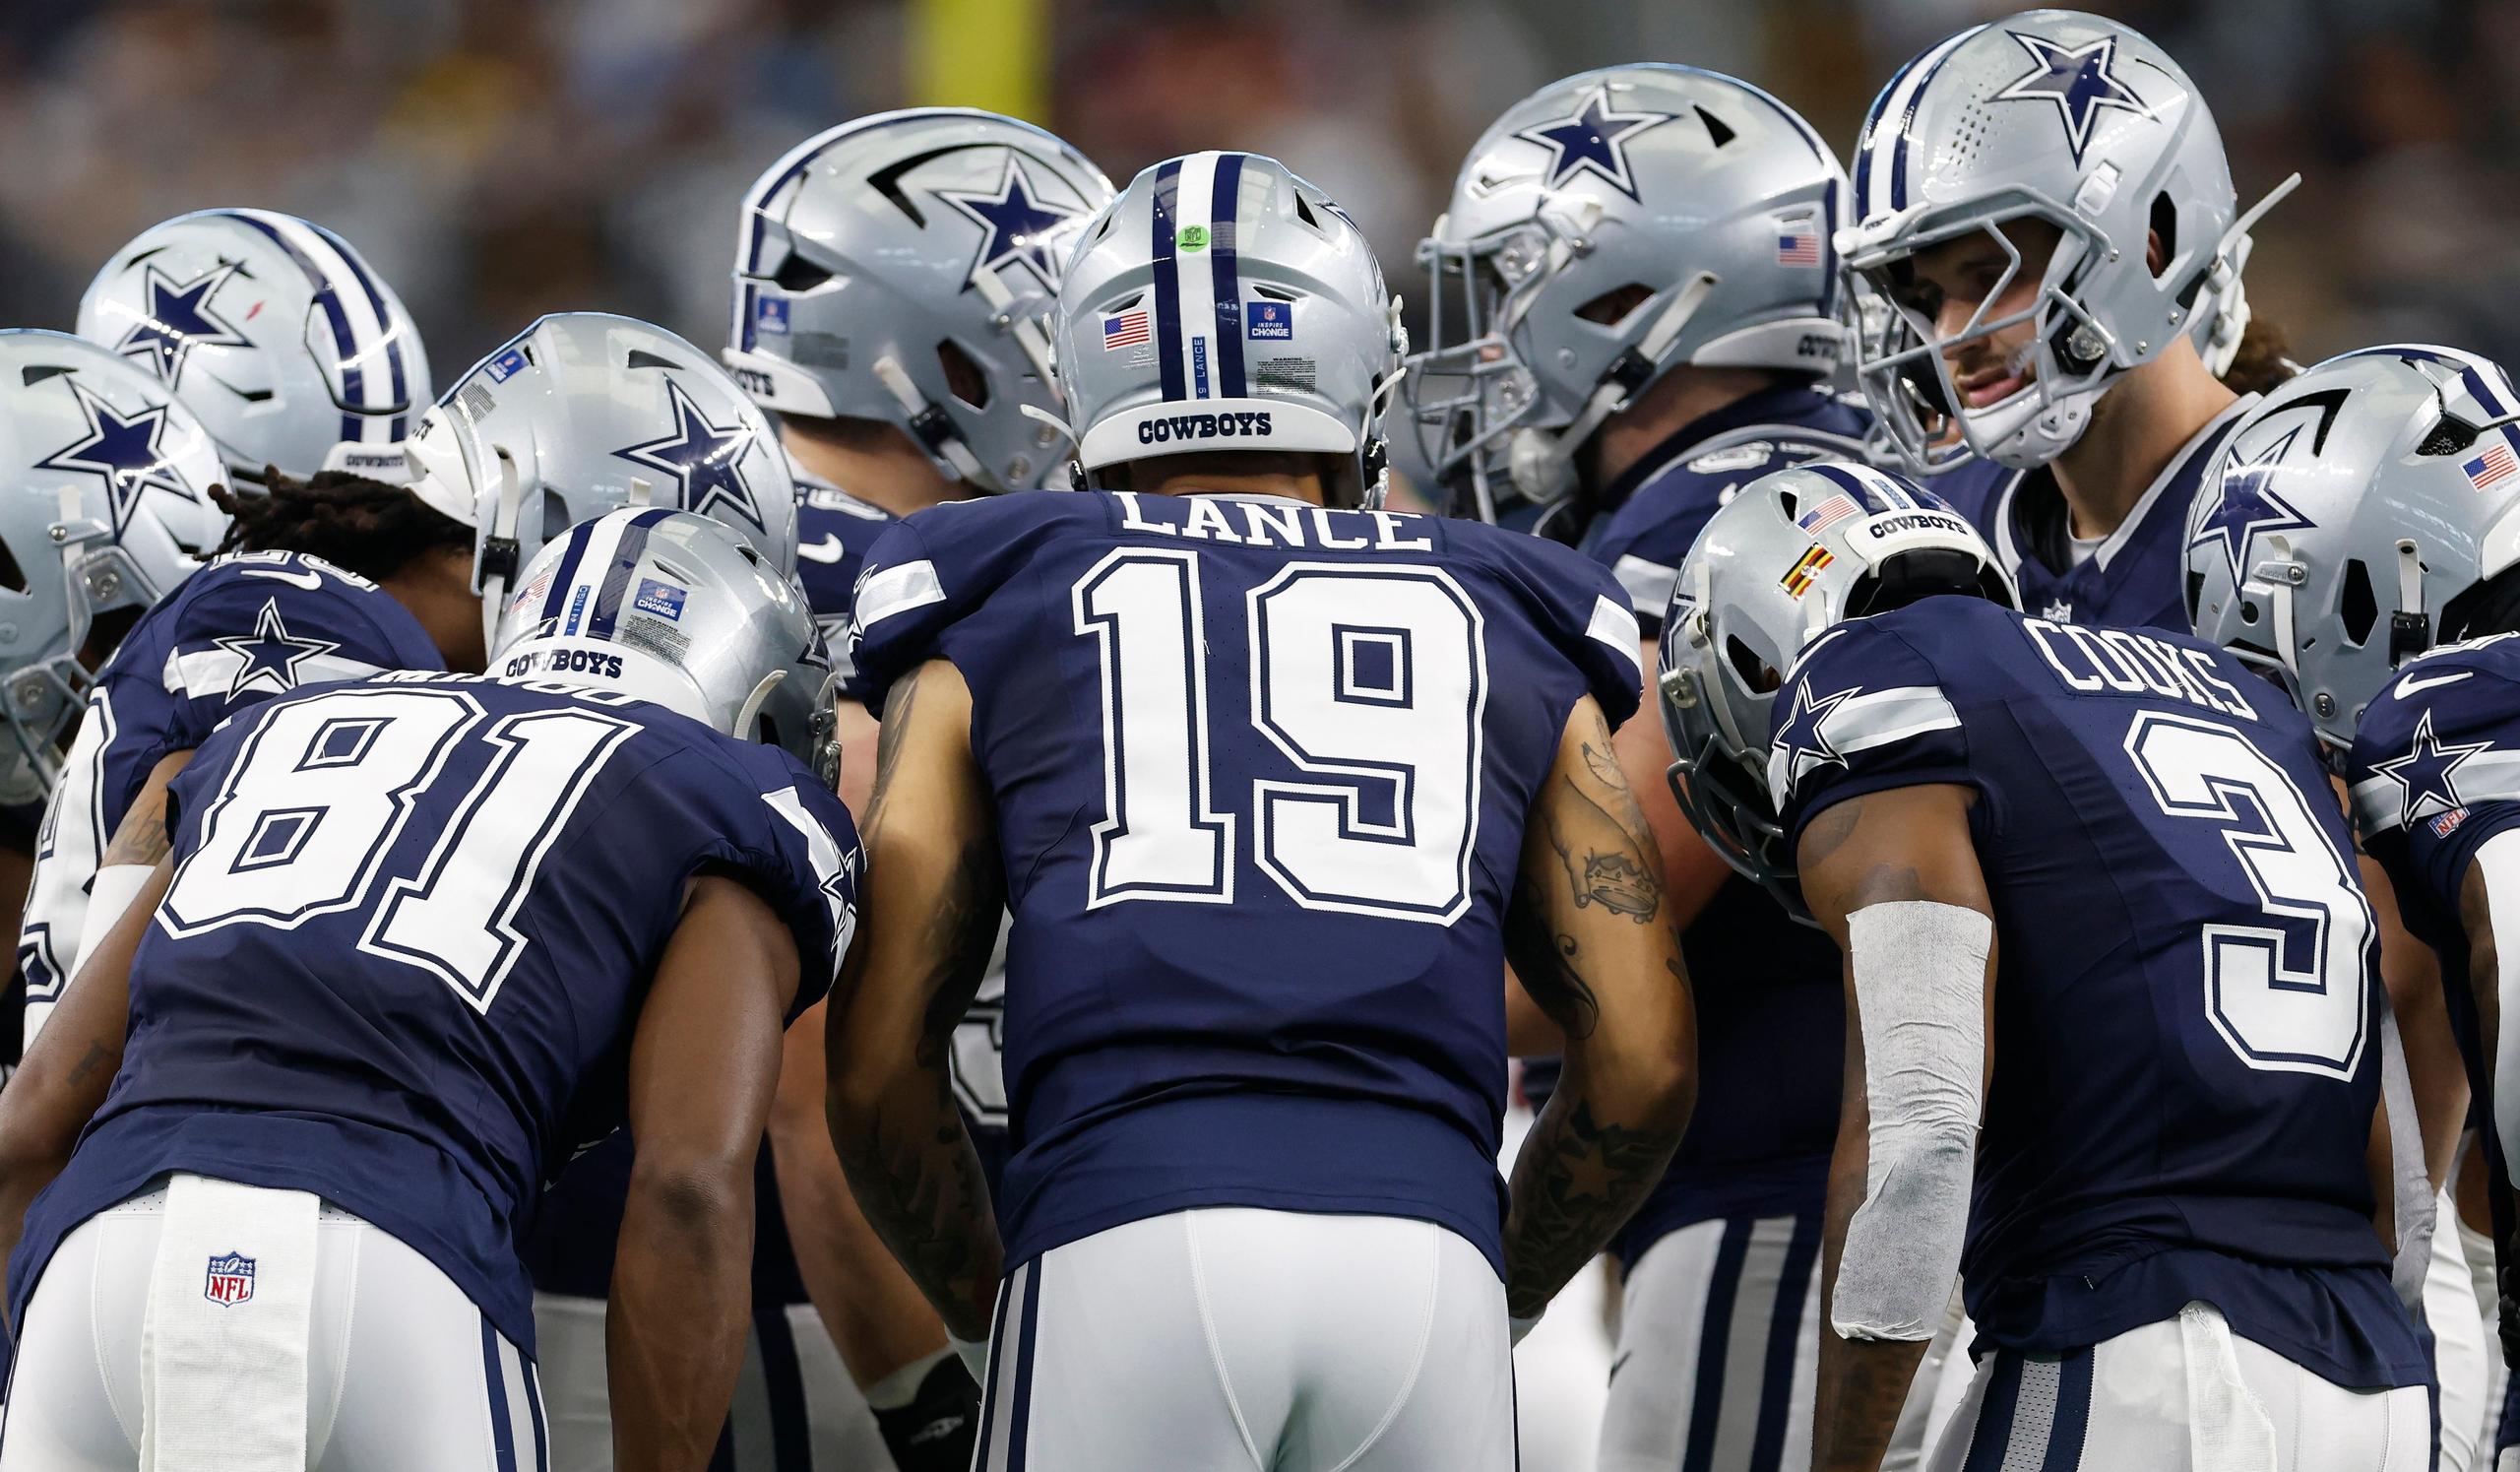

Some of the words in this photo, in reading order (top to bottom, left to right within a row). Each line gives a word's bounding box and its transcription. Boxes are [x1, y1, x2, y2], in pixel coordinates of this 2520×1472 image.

[1251, 328, 1290, 337] CHANGE
[1194, 339, 1206, 378] LANCE
[1138, 413, 1272, 444] COWBOYS
[1112, 490, 1432, 551] LANCE
[1869, 515, 1969, 539] COWBOYS
[637, 599, 678, 617] CHANGE
[645, 596, 674, 608] INSPIRE
[506, 649, 624, 679] COWBOYS
[2023, 617, 2258, 722] COOKS
[1072, 545, 1488, 928] 19
[2437, 808, 2466, 834] NFL
[154, 686, 646, 1016] 81
[2122, 709, 2376, 1083] 3
[210, 1275, 249, 1303] NFL
